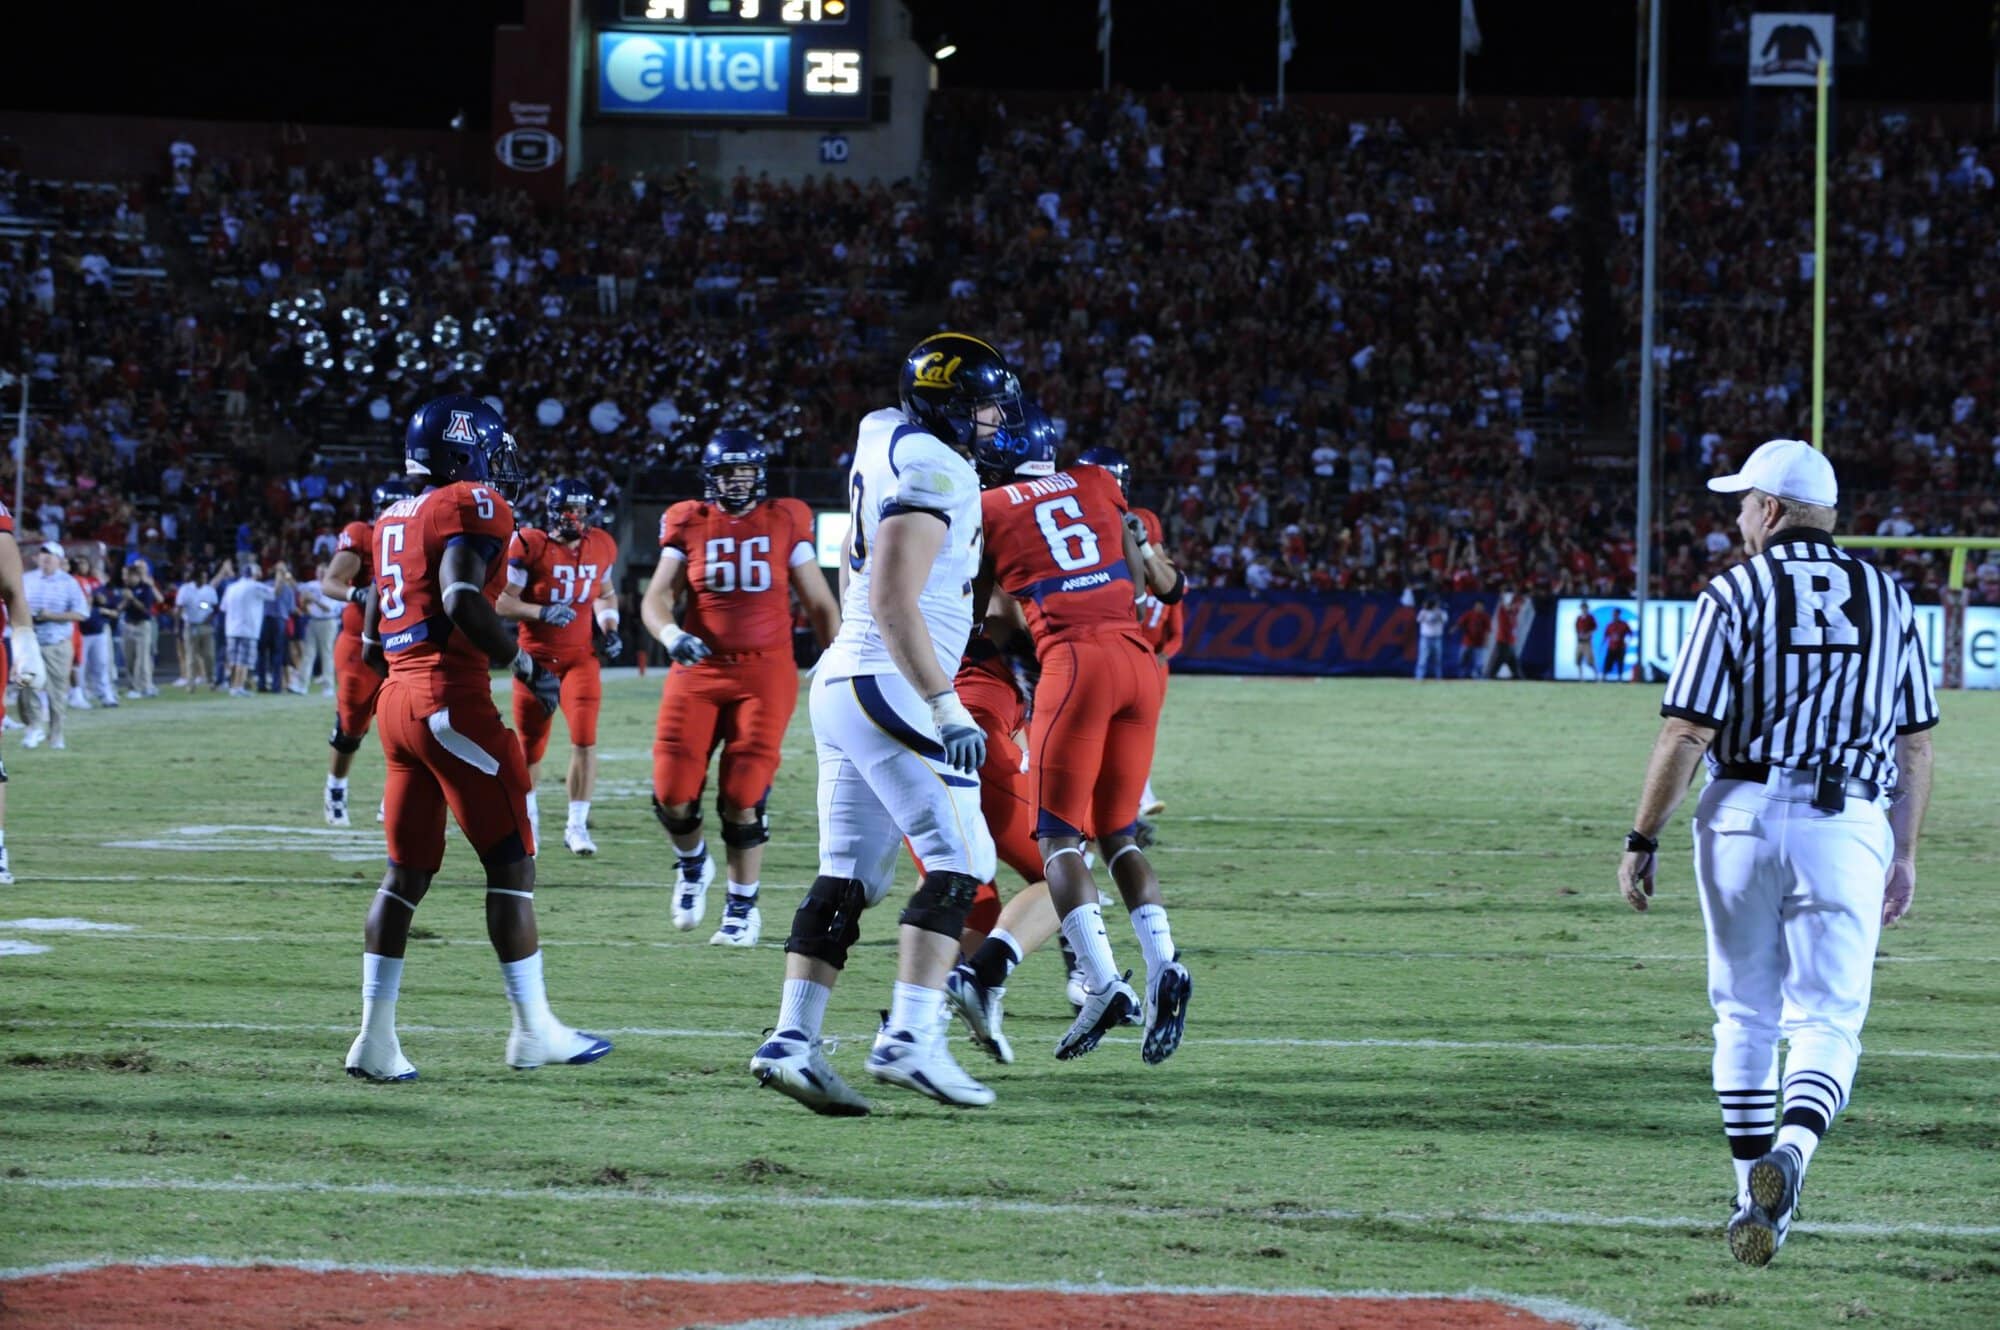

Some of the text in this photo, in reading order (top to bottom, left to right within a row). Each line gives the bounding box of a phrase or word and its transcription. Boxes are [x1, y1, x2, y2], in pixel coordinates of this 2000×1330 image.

[636, 38, 780, 94] alltel
[804, 50, 860, 93] 25
[821, 140, 848, 160] 10
[912, 351, 963, 387] Cal
[443, 410, 477, 444] A
[471, 487, 495, 520] 5
[1034, 496, 1101, 572] 6
[377, 523, 406, 621] 5
[551, 564, 598, 605] 37
[704, 536, 772, 593] 66
[1062, 572, 1112, 592] ARIZONA
[1782, 560, 1859, 646] R
